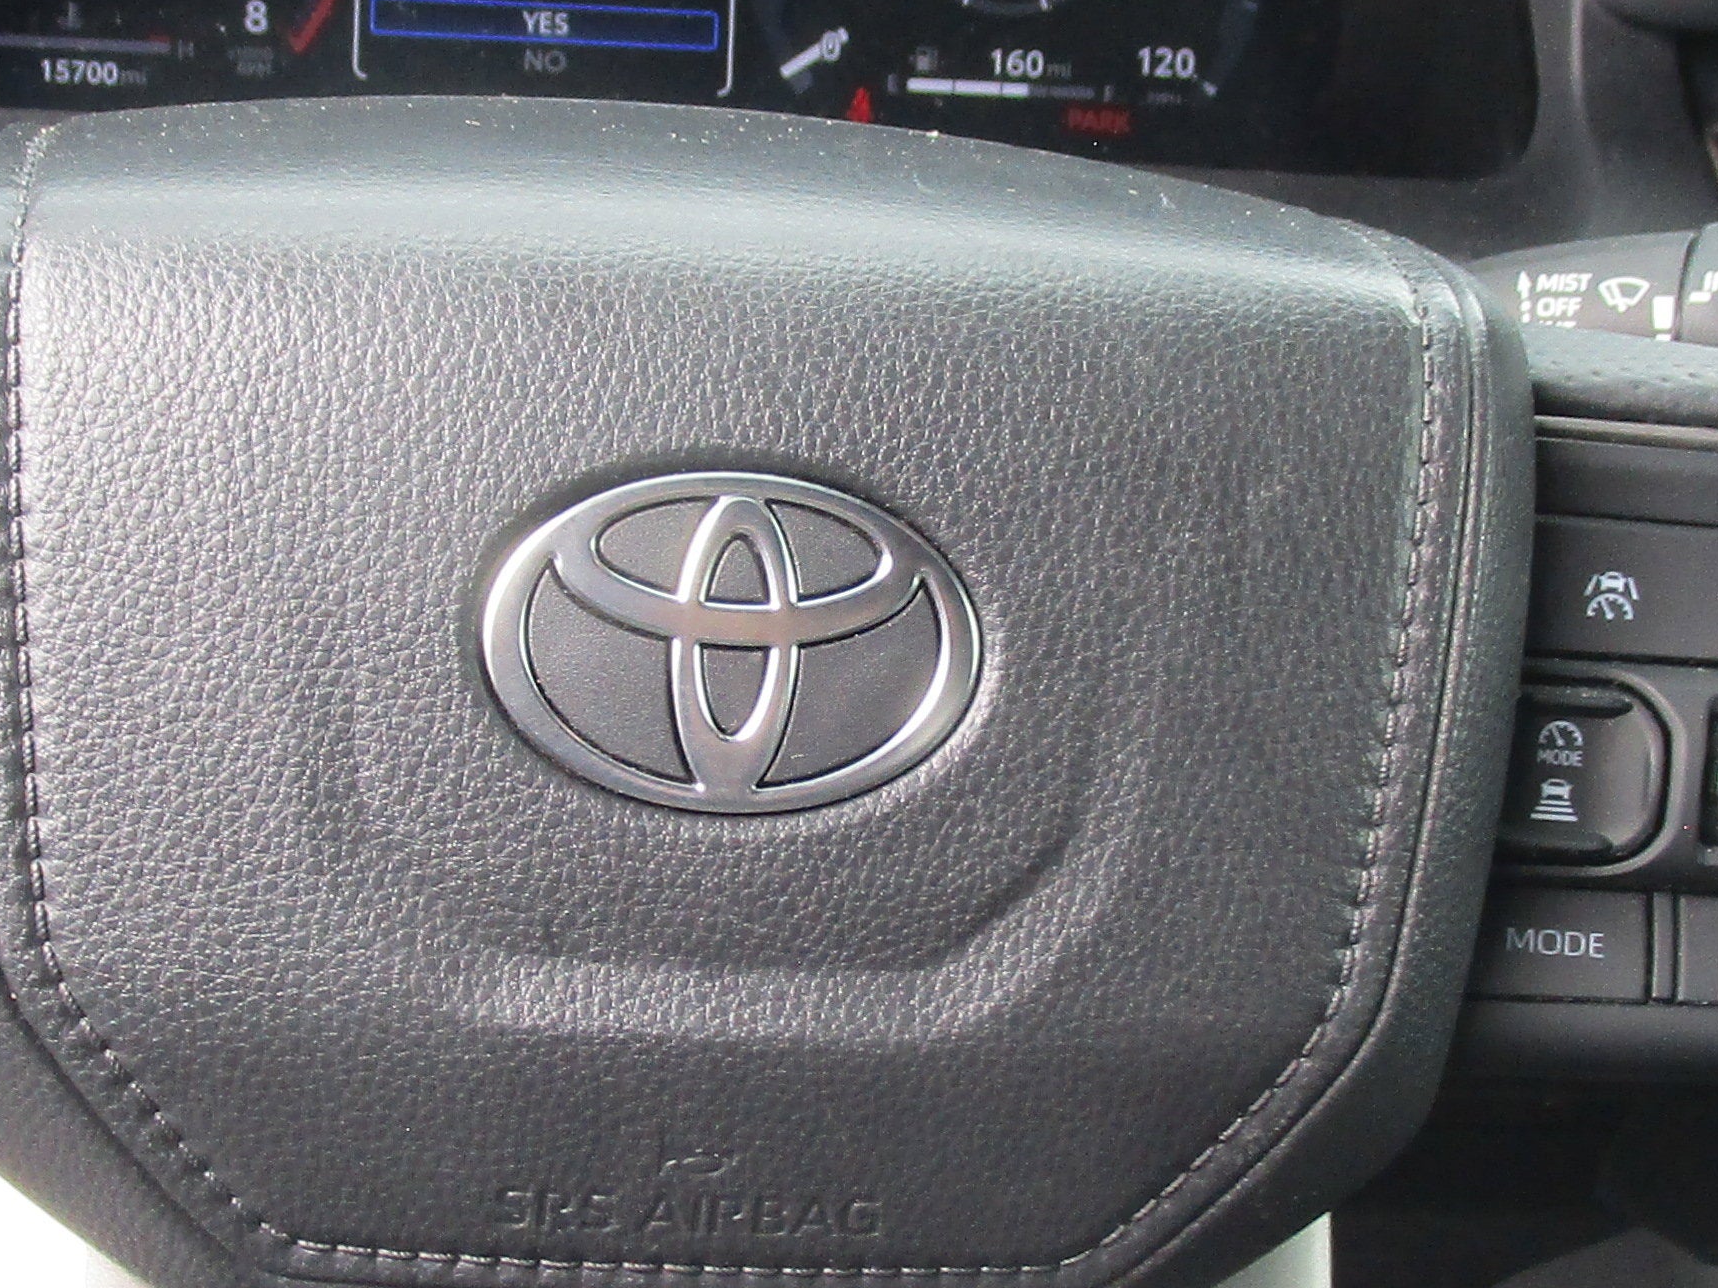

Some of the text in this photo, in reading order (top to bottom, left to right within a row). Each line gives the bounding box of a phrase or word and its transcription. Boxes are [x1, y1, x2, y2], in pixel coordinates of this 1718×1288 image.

[522, 10, 570, 36] YES
[523, 47, 567, 73] NO
[820, 29, 843, 63] 0
[40, 58, 120, 87] 15700
[990, 48, 1044, 79] 160
[1137, 46, 1196, 79] 120
[1535, 272, 1594, 293] MIST
[1536, 296, 1583, 318] OFF
[1536, 748, 1583, 768] MODE
[1504, 926, 1606, 960] MODE
[641, 1192, 885, 1239] AIRBAG
